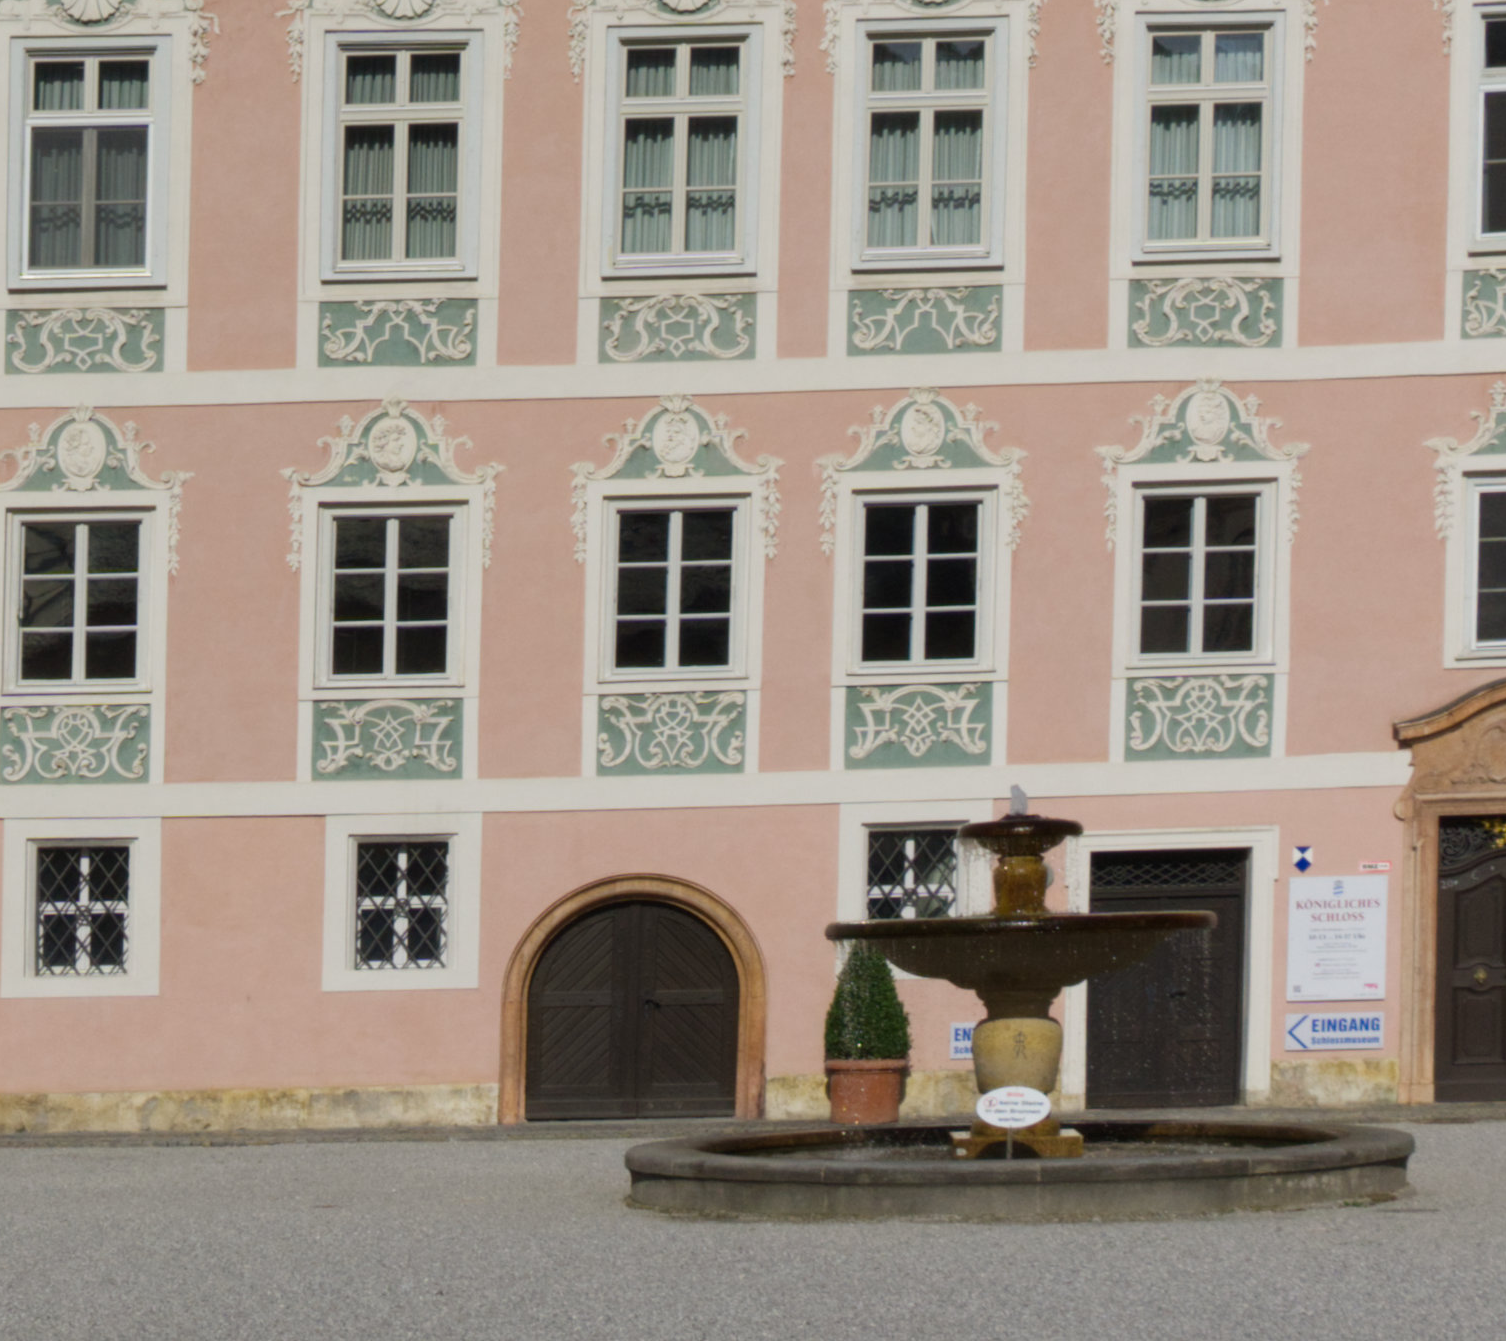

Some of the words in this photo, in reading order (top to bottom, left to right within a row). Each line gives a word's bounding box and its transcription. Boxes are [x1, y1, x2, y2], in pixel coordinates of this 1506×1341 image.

[1296, 898, 1380, 910] KÖNIGLICHES
[1310, 912, 1365, 922] SCHLOSS
[1311, 1018, 1380, 1032] EINGANG
[954, 1028, 974, 1041] EN
[1311, 1037, 1380, 1045] Schlossmuseum
